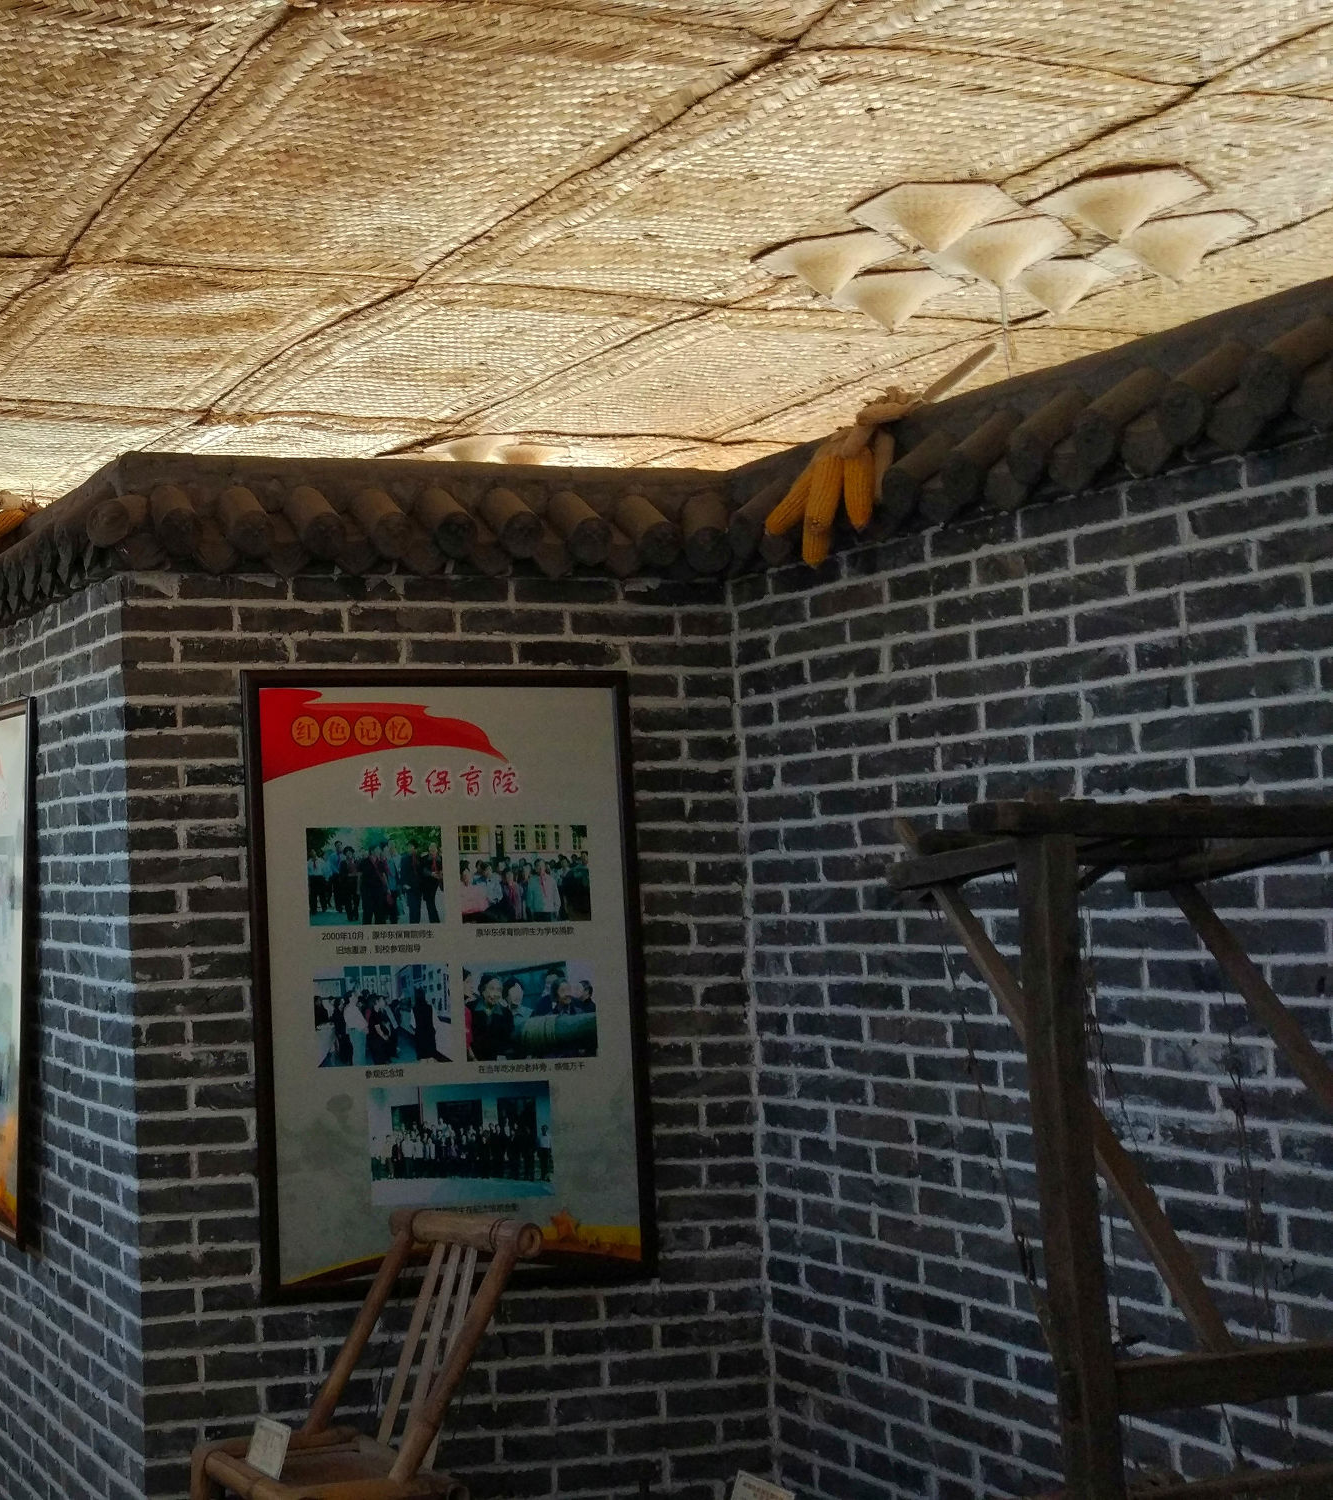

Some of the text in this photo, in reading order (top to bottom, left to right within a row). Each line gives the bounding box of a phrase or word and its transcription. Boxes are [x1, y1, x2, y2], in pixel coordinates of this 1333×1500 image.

[295, 717, 412, 744] 红色记忆
[358, 765, 520, 797] 華東保育院
